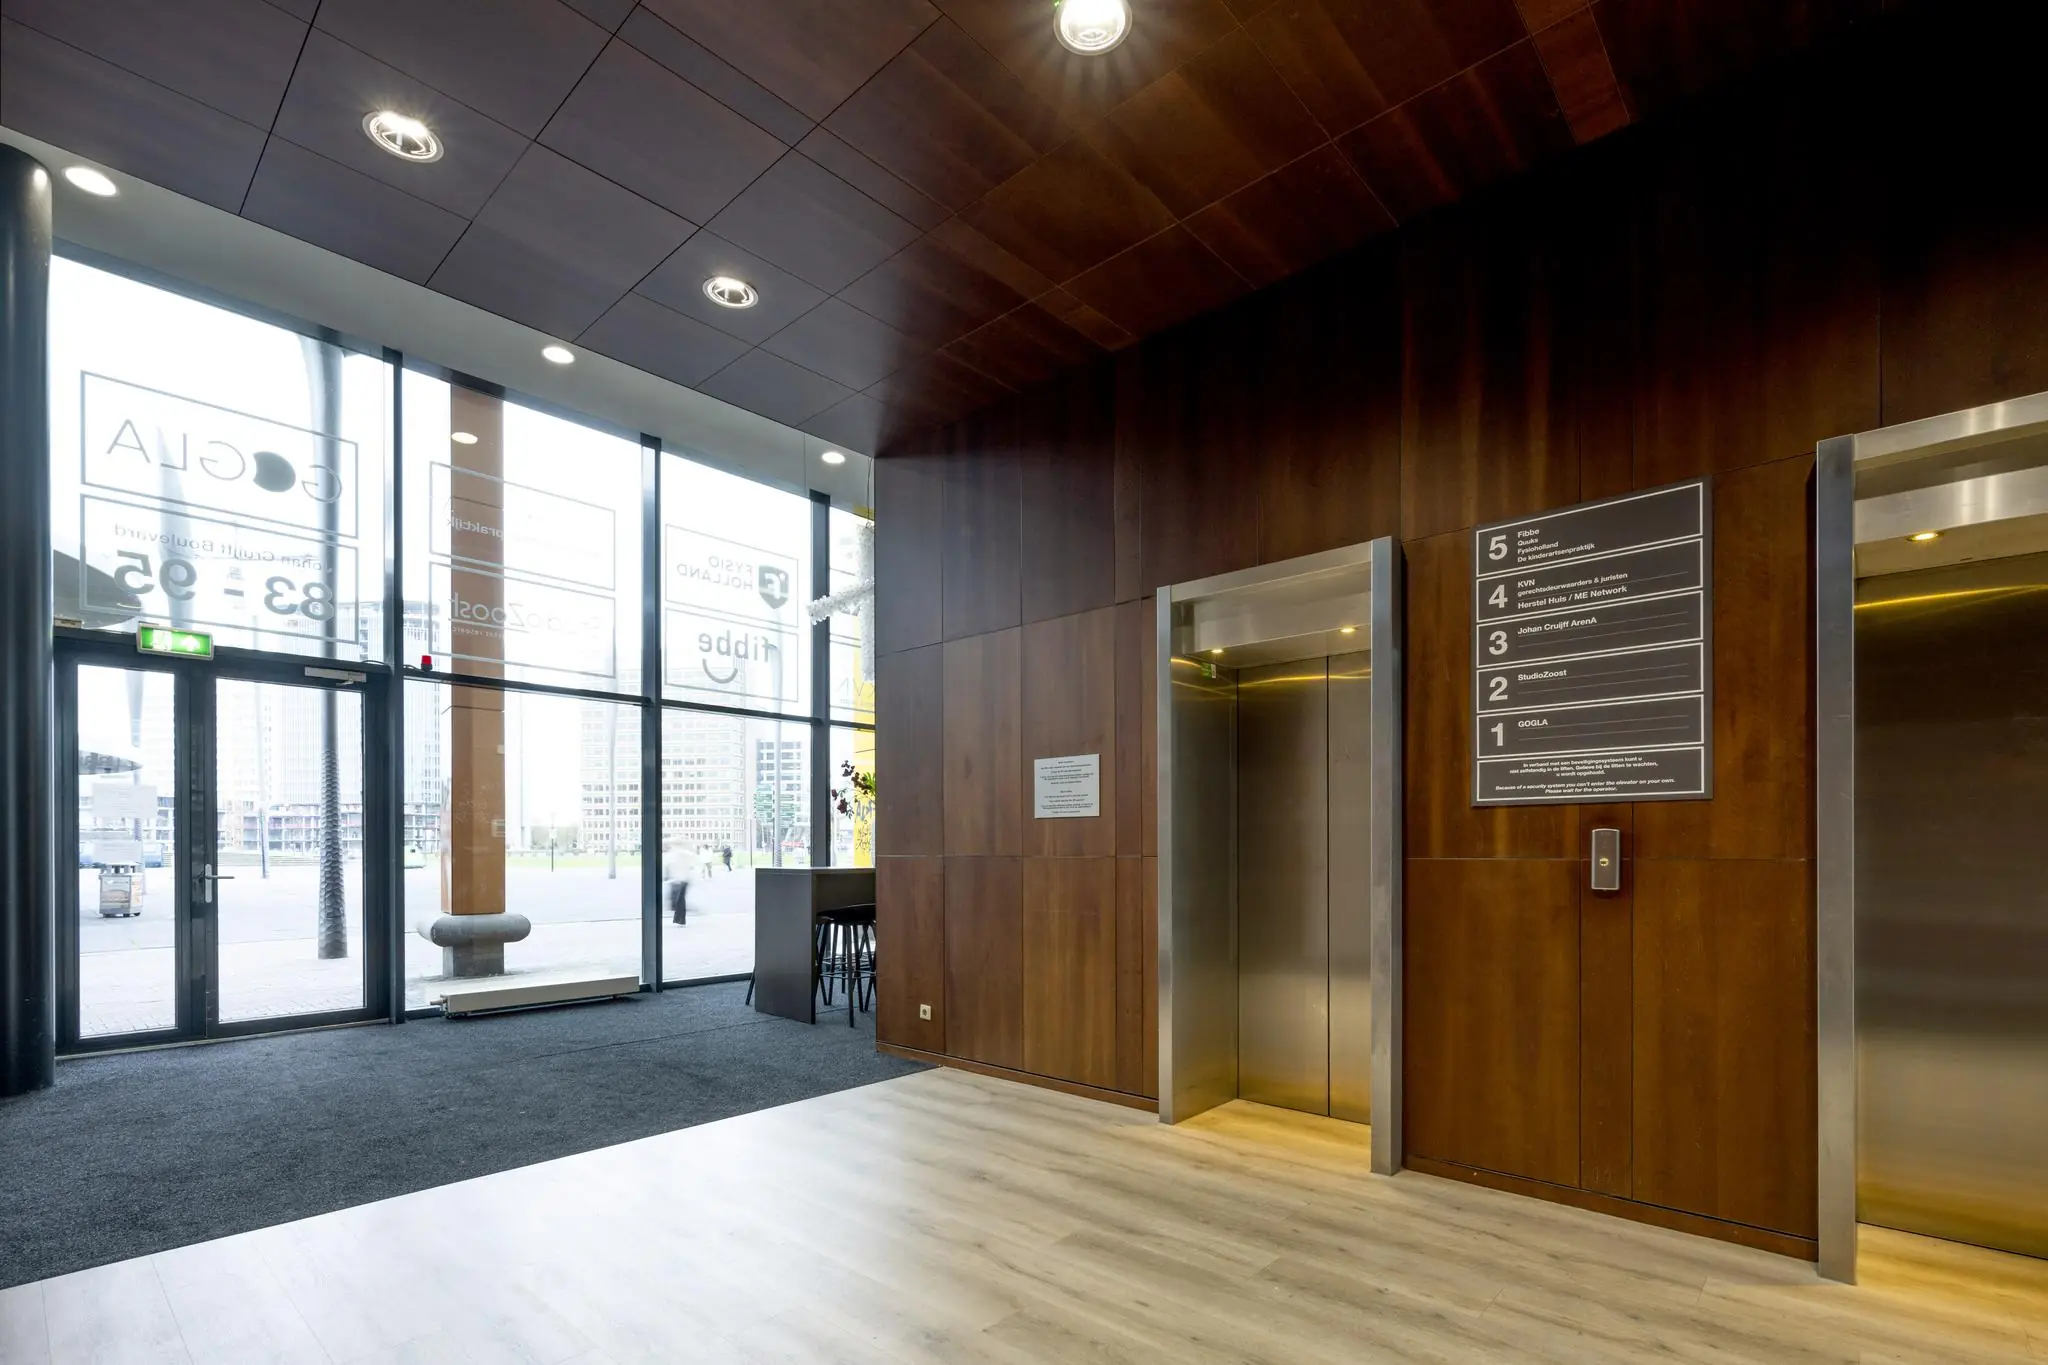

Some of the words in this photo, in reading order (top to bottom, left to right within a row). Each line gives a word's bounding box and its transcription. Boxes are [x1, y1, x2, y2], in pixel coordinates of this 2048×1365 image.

[1517, 529, 1540, 538] Fibbe
[1488, 535, 1508, 560] 5
[1517, 541, 1559, 555] Fysioholland
[1528, 543, 1596, 561] kinderartsenpraktijk
[1517, 579, 1535, 588] KVN
[1517, 579, 1592, 597] gerechtsdeurwaarders
[1601, 573, 1628, 584] juristen
[1488, 584, 1508, 609] 4
[1518, 599, 1547, 610] Herstel
[1548, 596, 1567, 605] Huis
[1574, 592, 1588, 601] ME
[1590, 585, 1628, 598] Network
[1517, 625, 1543, 635] Johan
[1544, 620, 1569, 632] Cruijff
[1571, 617, 1598, 628] ArenA
[1488, 631, 1508, 655] 3
[1517, 669, 1567, 681] StudioZoost
[1488, 677, 1508, 701] 2
[1517, 719, 1549, 728] GOGLA
[1491, 723, 1504, 747] 1
